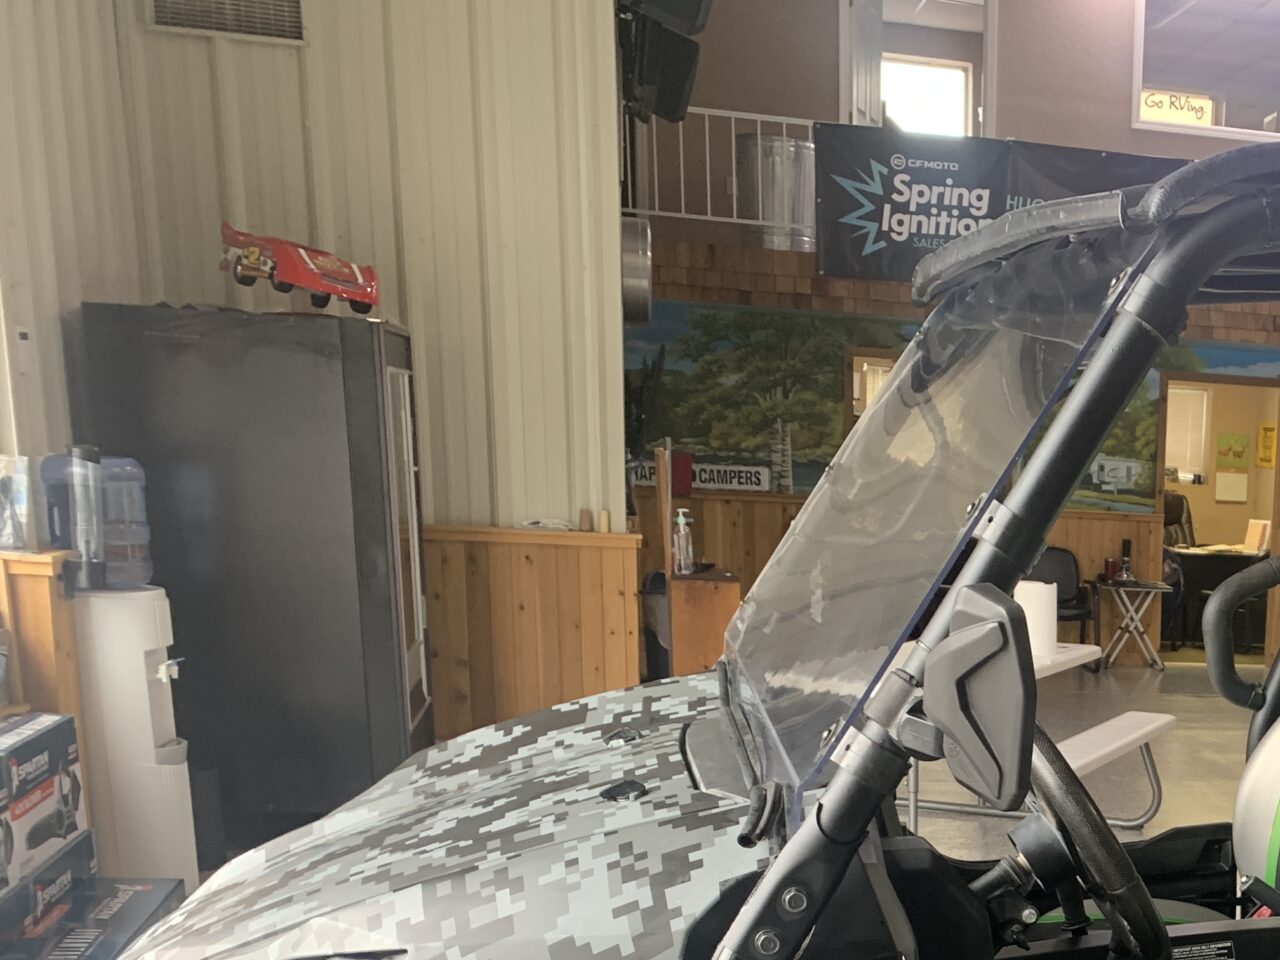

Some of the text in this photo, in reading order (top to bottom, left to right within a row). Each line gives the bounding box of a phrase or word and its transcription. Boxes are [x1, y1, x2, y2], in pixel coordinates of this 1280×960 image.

[1145, 93, 1164, 109] Go
[908, 158, 959, 171] CFMOTO
[891, 173, 990, 216] Spring
